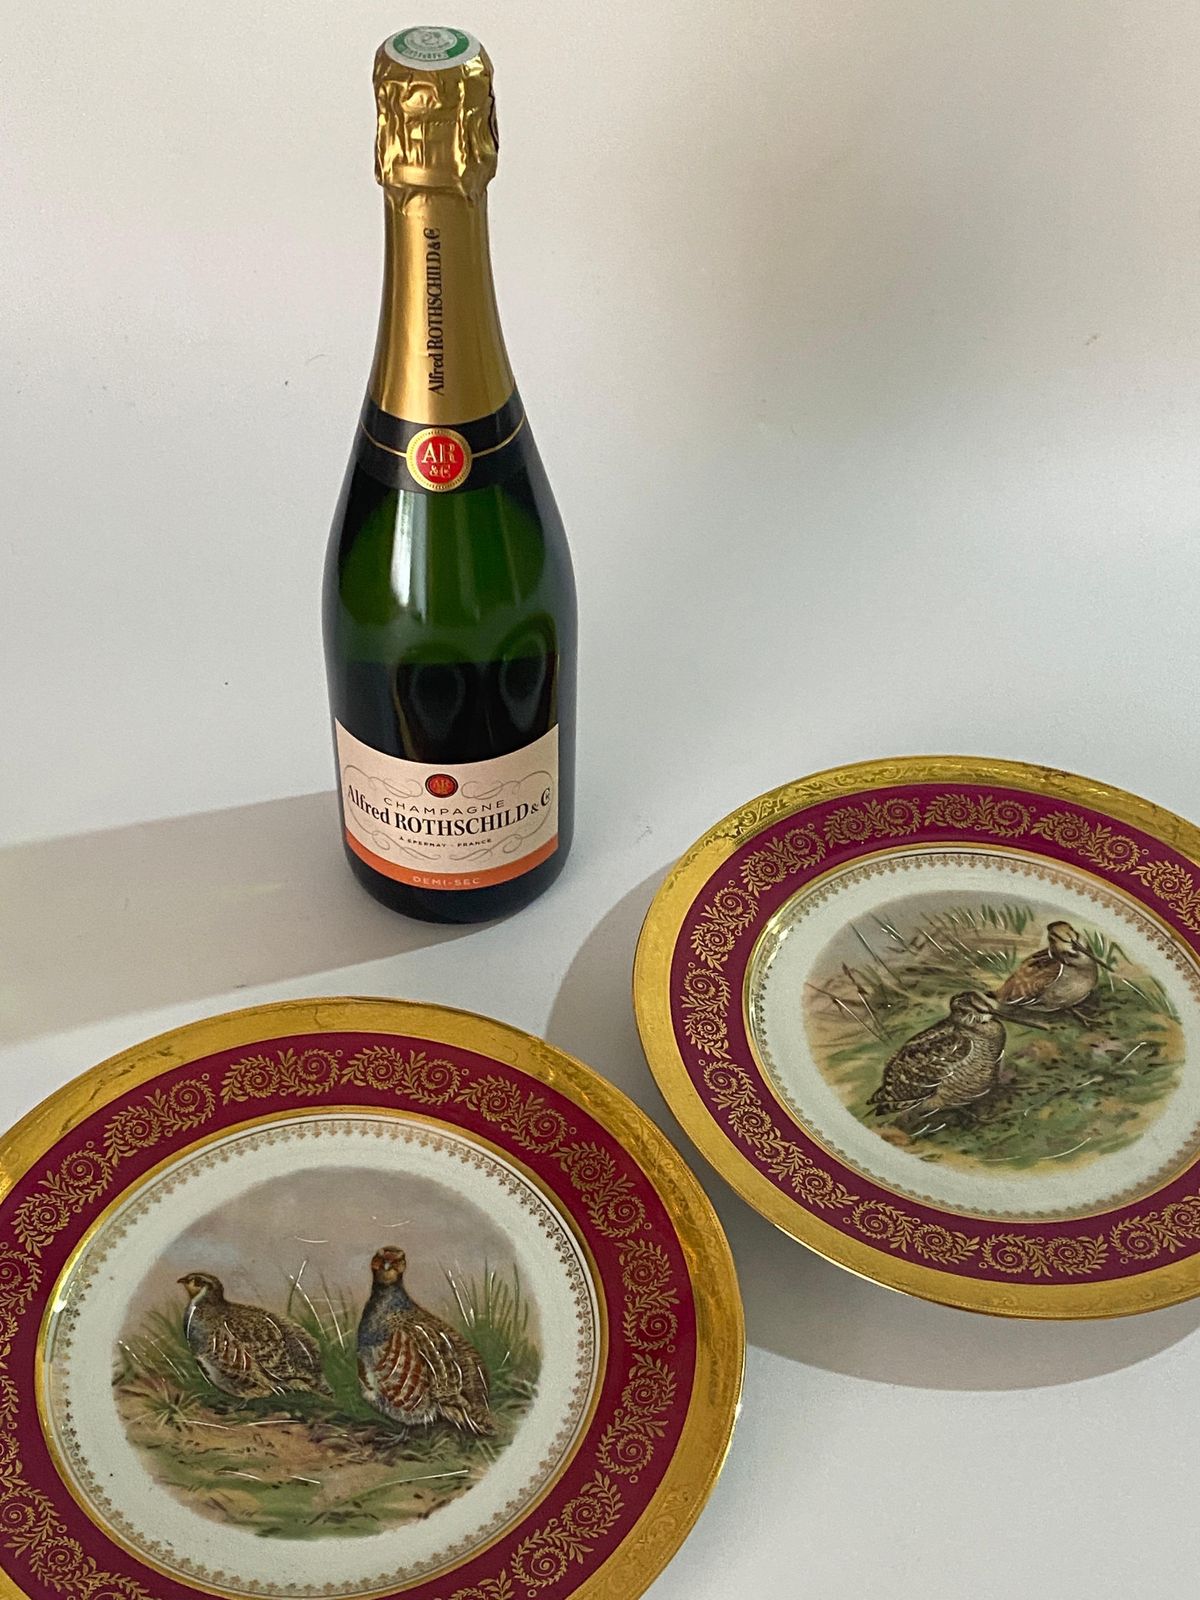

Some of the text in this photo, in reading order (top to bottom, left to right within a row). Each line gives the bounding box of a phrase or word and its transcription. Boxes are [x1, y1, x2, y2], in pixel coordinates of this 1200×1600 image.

[428, 352, 445, 396] Alfred
[421, 442, 457, 464] AR
[347, 785, 391, 826] Alfred
[384, 797, 505, 816] CHAMPAGNE
[457, 838, 492, 847] FRANCE
[412, 875, 481, 887] DEMI-SEC
